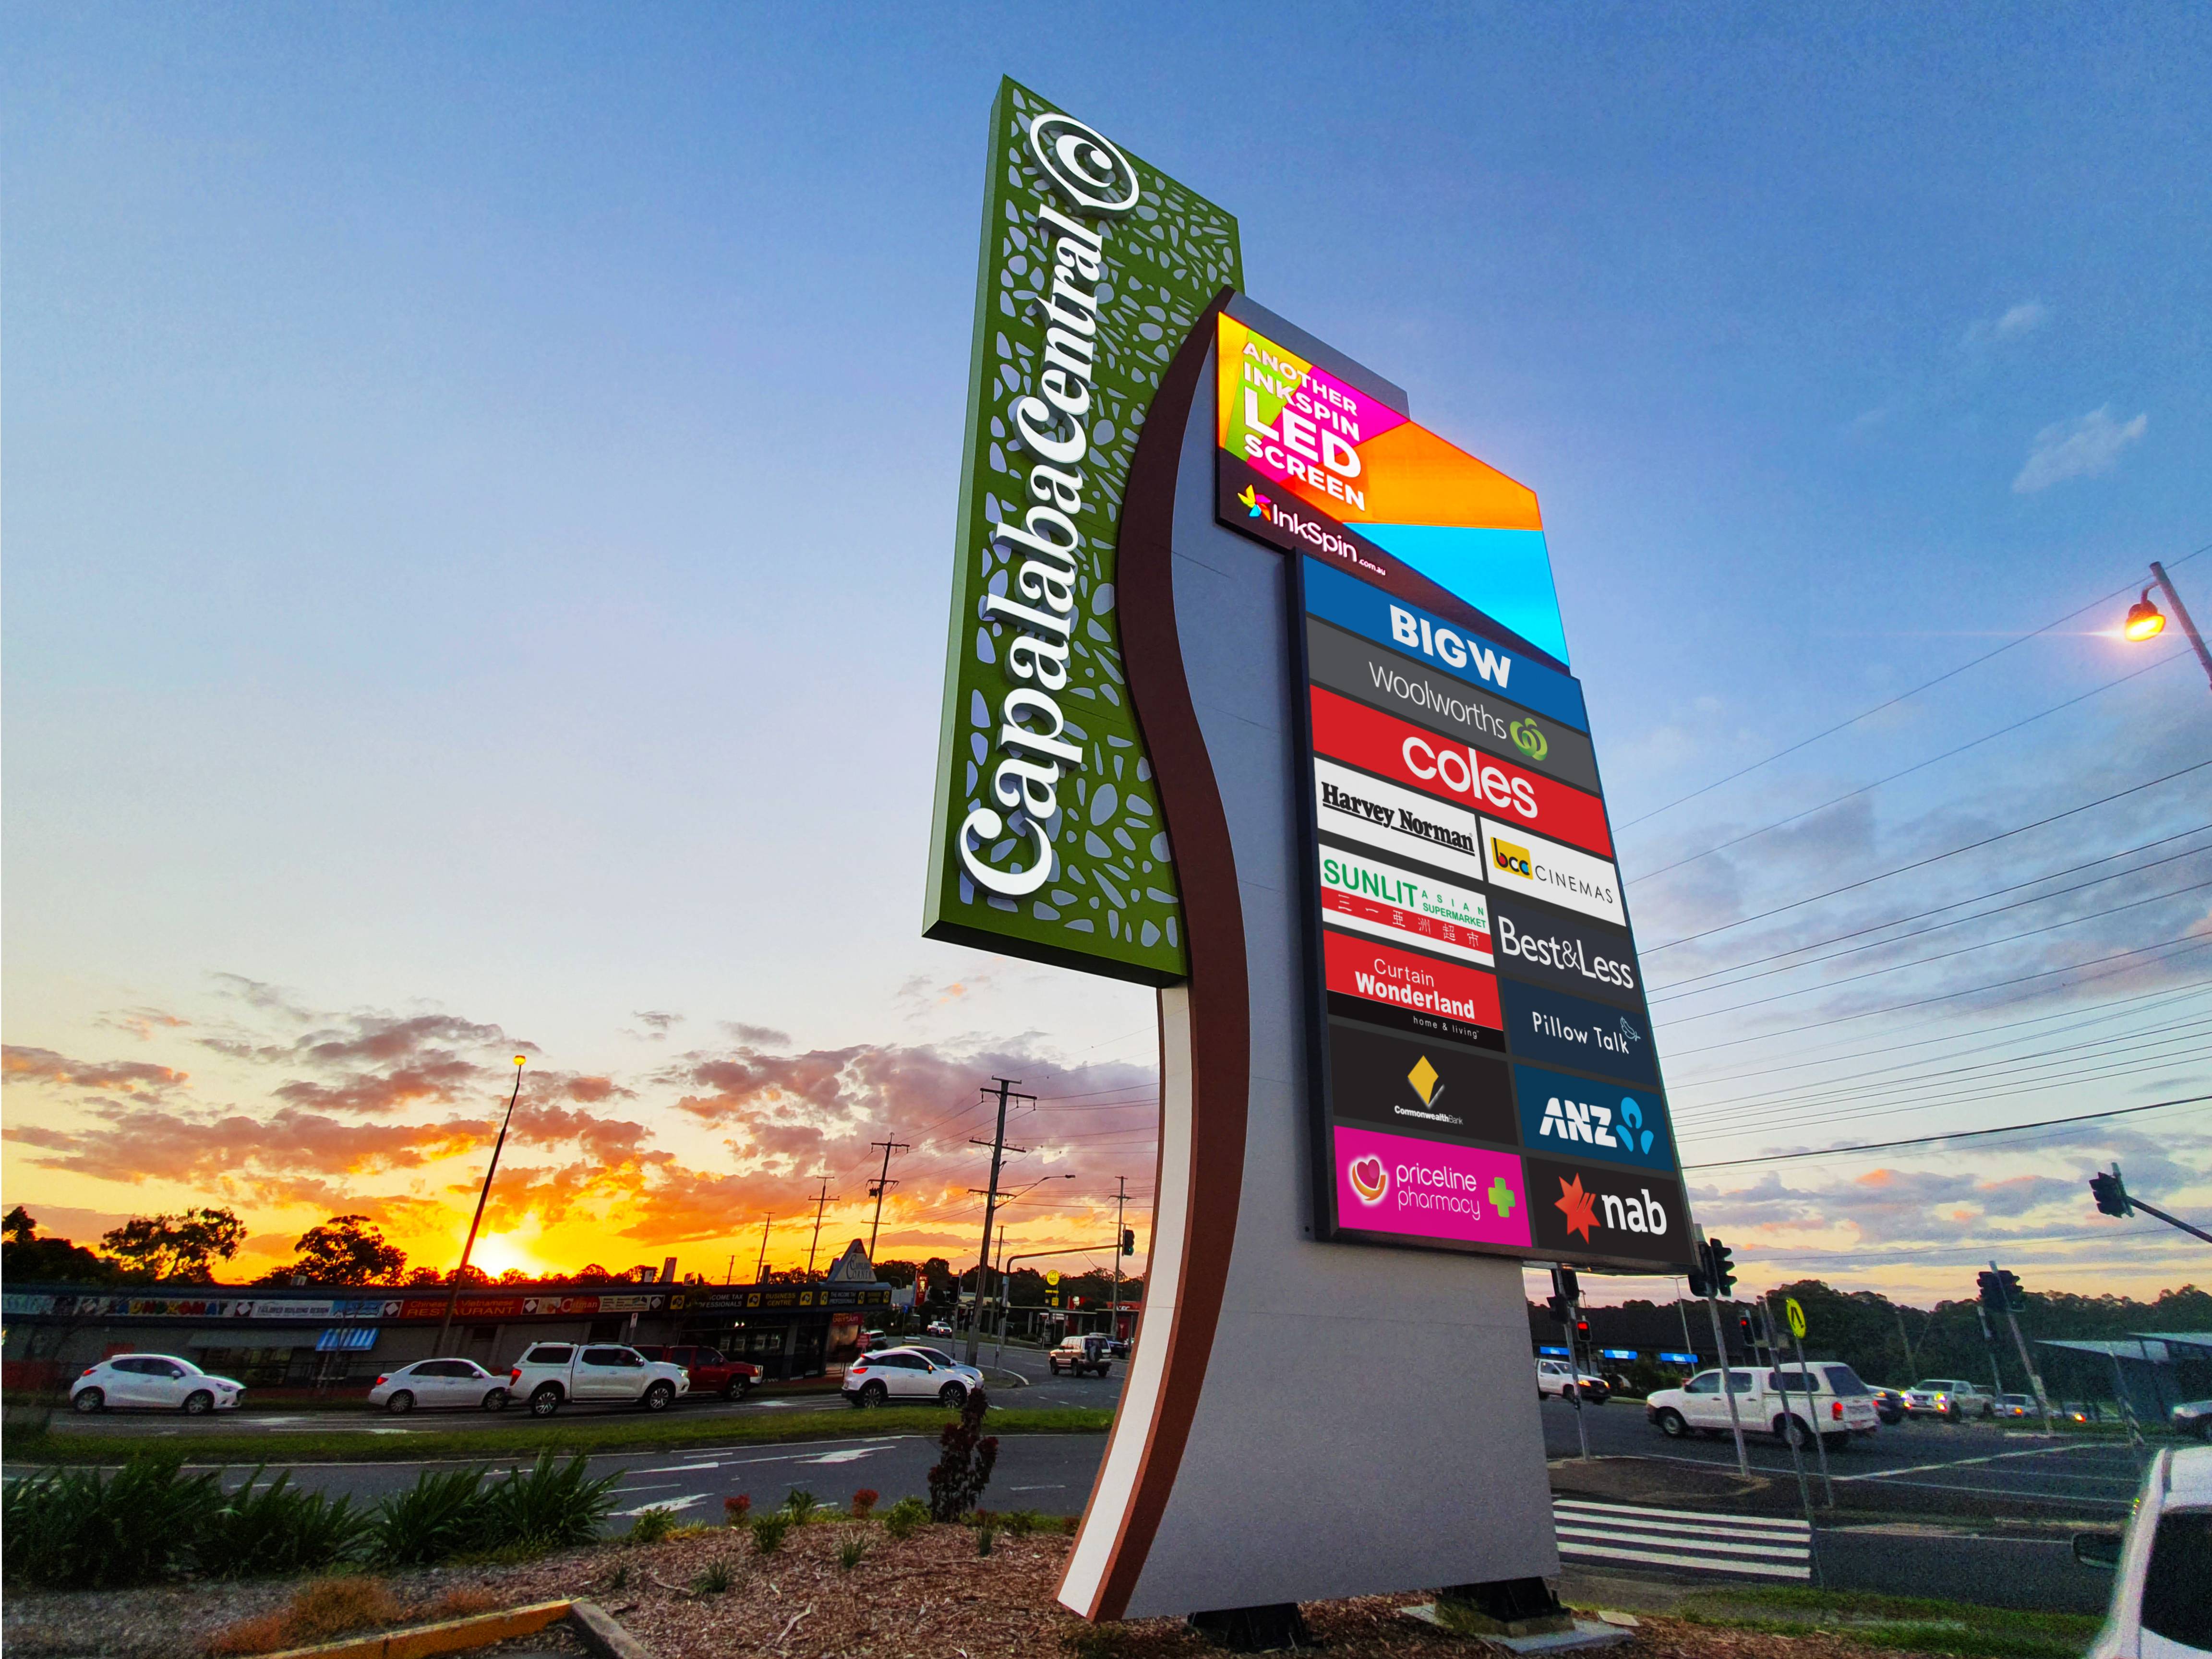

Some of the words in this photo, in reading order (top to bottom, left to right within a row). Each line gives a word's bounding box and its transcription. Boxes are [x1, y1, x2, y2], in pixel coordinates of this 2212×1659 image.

[1242, 342, 1358, 417] ANOTHER
[1244, 361, 1359, 441] INKSPIN
[1244, 386, 1361, 478] LED
[1244, 433, 1365, 512] SCREEN
[1272, 503, 1358, 563] InkSpin
[1369, 661, 1507, 739] Woolworths
[1402, 736, 1538, 818] coles
[1321, 781, 1395, 828] Harvey
[1398, 808, 1475, 852] Norman
[1323, 859, 1418, 908] SUNLIT
[1492, 837, 1530, 876] bcc
[1535, 865, 1613, 904] CINEMAS
[1423, 902, 1487, 928] SUPERMARKET
[1374, 958, 1434, 987] Curtain
[1498, 915, 1634, 989] Best&Less
[1355, 971, 1475, 1020] Wonderland
[1413, 1016, 1437, 1029] home
[1443, 1022, 1448, 1031] &
[1532, 1011, 1588, 1044] Pillow
[1593, 1025, 1630, 1055] Talk
[1539, 1097, 1617, 1148] ANZ
[1396, 1163, 1477, 1192] priceline
[1398, 1189, 1480, 1221] pharmacy
[1601, 1188, 1668, 1235] nab
